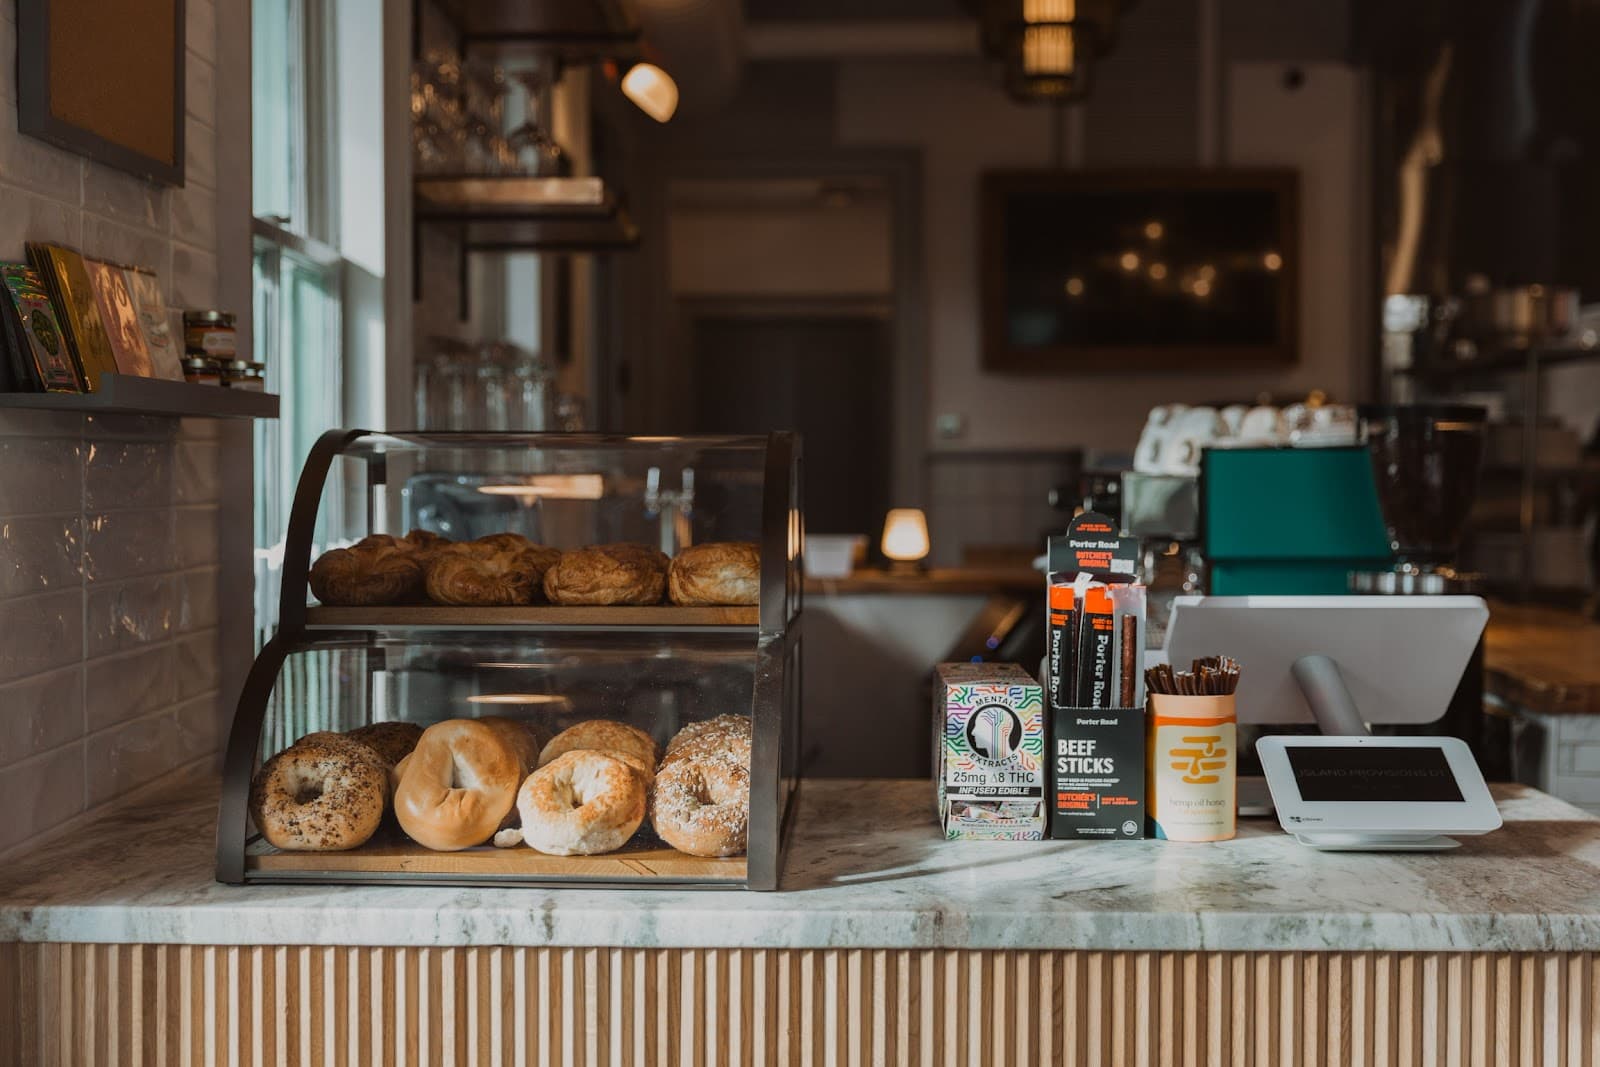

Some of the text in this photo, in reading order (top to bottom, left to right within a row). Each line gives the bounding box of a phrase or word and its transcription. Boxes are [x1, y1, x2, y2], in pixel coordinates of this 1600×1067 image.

[1069, 540, 1119, 549] Porter Road
[1052, 630, 1061, 674] Porter
[1095, 635, 1108, 679] Porter
[975, 696, 1014, 707] MENTAL
[1057, 739, 1097, 756] BEEF
[969, 752, 1018, 767] EXTRACTS
[1057, 757, 1114, 774] STICKS
[953, 771, 986, 785] 25mg
[1009, 772, 1035, 783] THC
[959, 786, 1030, 795] INFUSED EDIBLE
